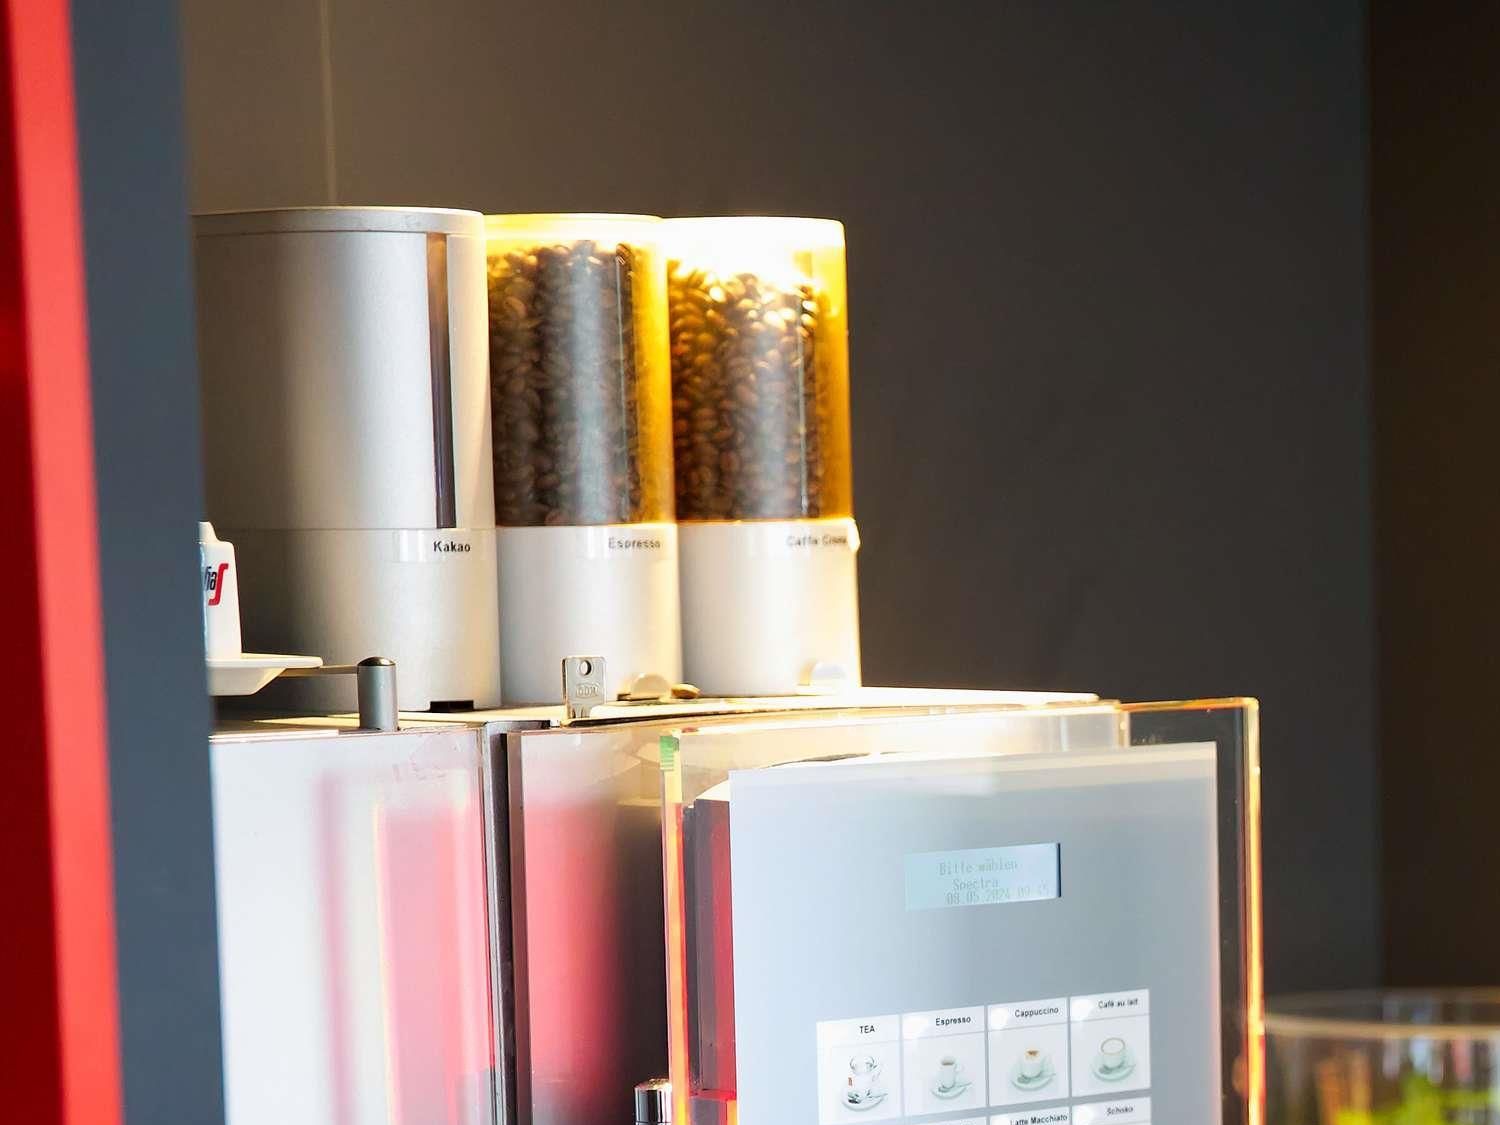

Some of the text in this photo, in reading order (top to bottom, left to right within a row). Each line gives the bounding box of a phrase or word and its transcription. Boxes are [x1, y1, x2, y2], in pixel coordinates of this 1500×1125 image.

[433, 541, 471, 553] Kakao
[608, 537, 661, 550] Espresso
[1098, 999, 1115, 1009] Café
[1127, 997, 1139, 1006] lait
[1014, 1006, 1060, 1018] Cappuccino
[935, 1016, 972, 1026] Espresso
[859, 1025, 876, 1034] TEA
[1030, 1114, 1068, 1125] Macchiato
